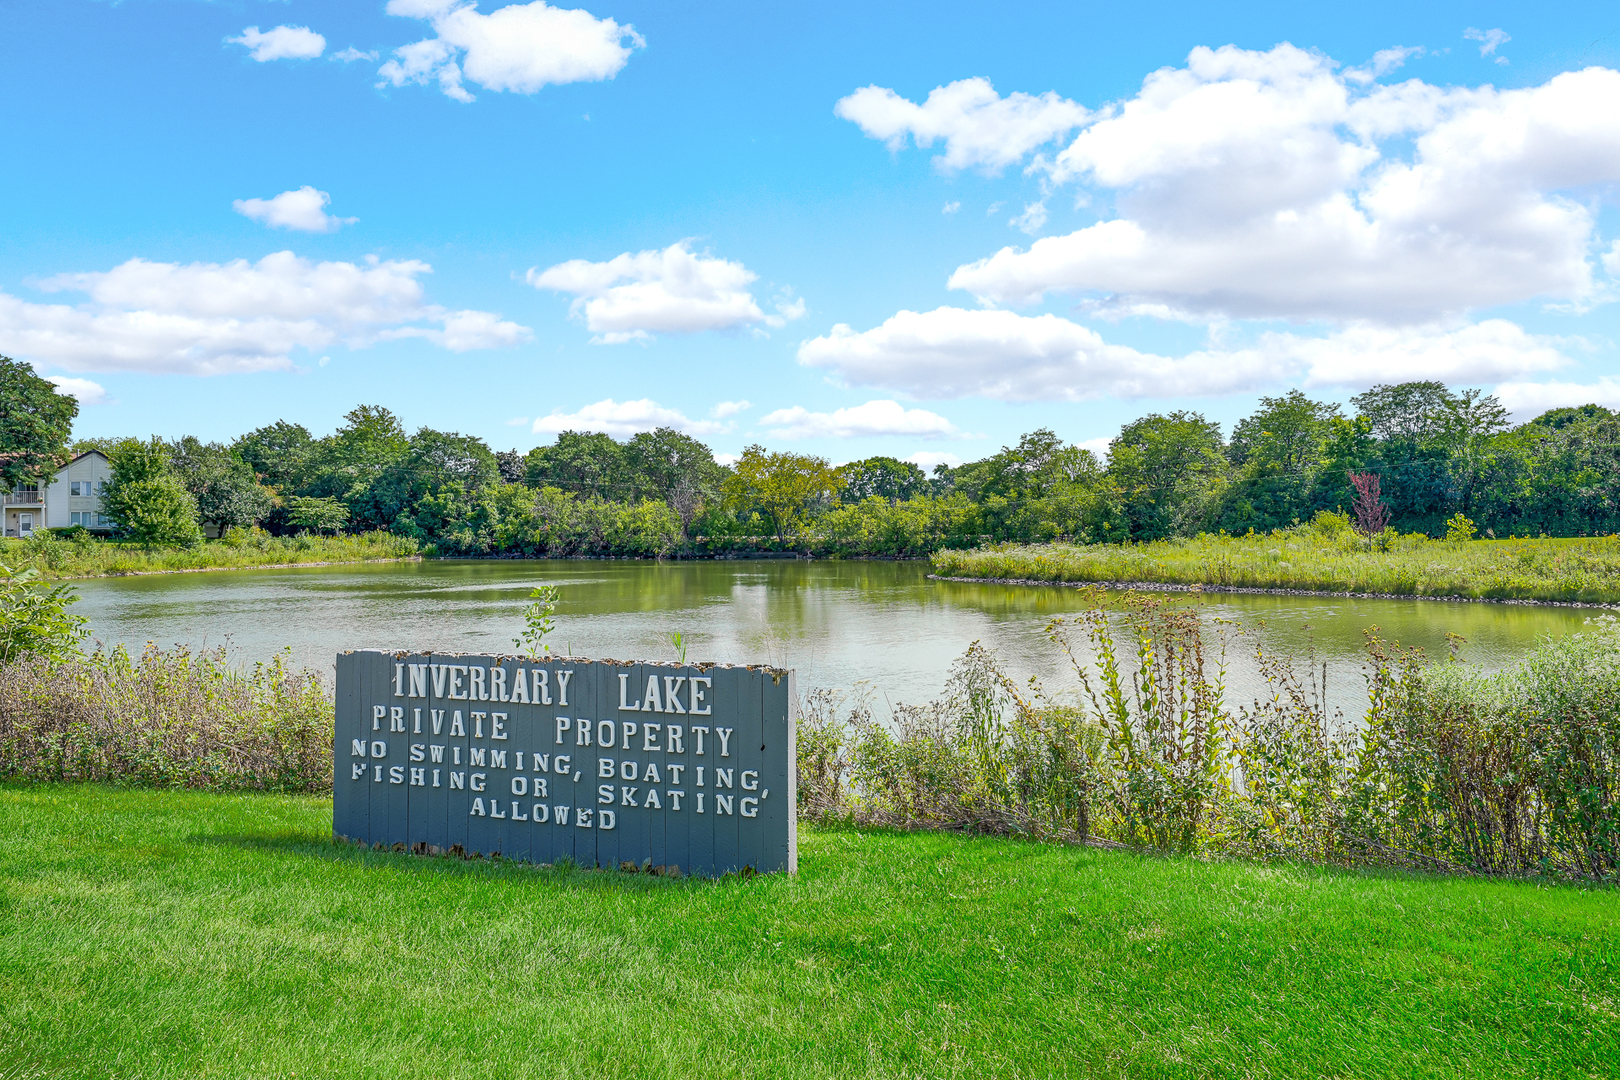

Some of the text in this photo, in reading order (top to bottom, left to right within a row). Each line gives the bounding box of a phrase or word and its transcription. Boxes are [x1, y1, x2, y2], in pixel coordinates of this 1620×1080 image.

[394, 662, 713, 716] INVERRARY LAKE
[372, 704, 733, 757] PRIVATE PROPERTY
[351, 738, 769, 800] NO SWIMMING, BOATING,
[351, 762, 759, 818] FISHING OR SKATING
[469, 797, 616, 830] ALLOWED
